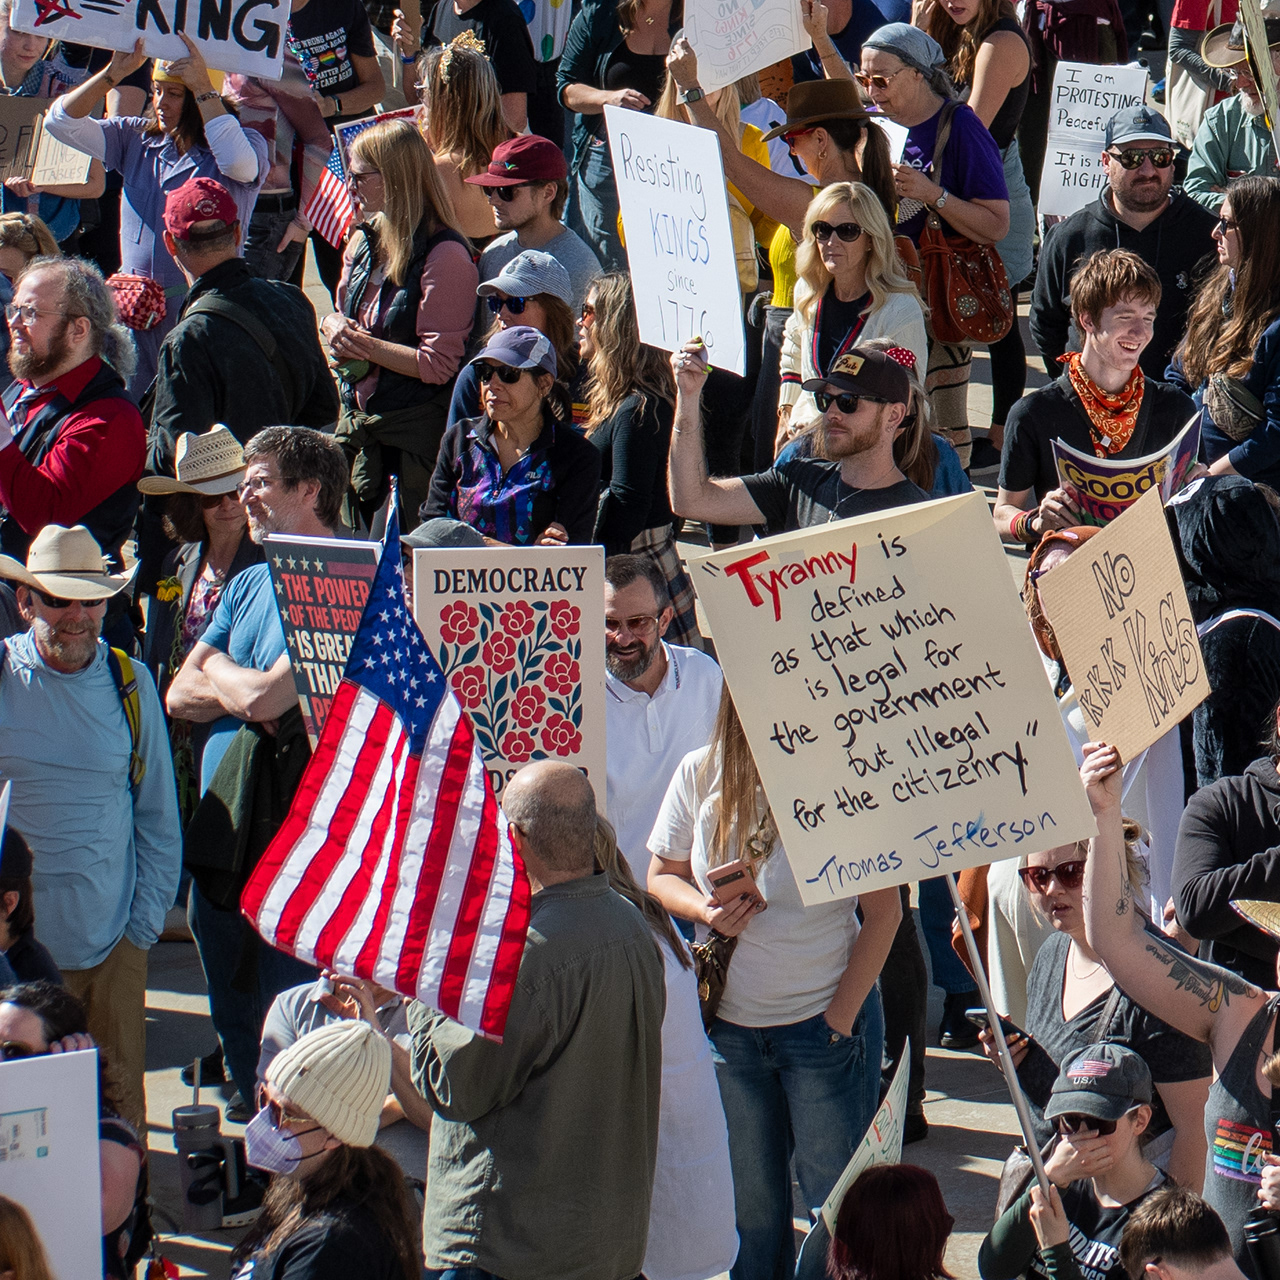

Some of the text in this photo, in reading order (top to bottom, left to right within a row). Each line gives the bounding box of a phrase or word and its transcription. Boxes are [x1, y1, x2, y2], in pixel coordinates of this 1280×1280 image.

[1057, 85, 1141, 109] PROTESTING
[1066, 69, 1114, 84] I am
[620, 132, 706, 221] Resisting
[650, 207, 710, 265] KINGS
[658, 298, 714, 348] 1776
[434, 566, 587, 595] DEMOCRACY
[810, 577, 906, 621] defined
[289, 601, 328, 627] OF THE
[771, 603, 956, 675] as that which
[770, 662, 1006, 756] the government
[848, 711, 989, 777] but illegal
[793, 786, 880, 832] for the
[1073, 1077, 1096, 1086] USA
